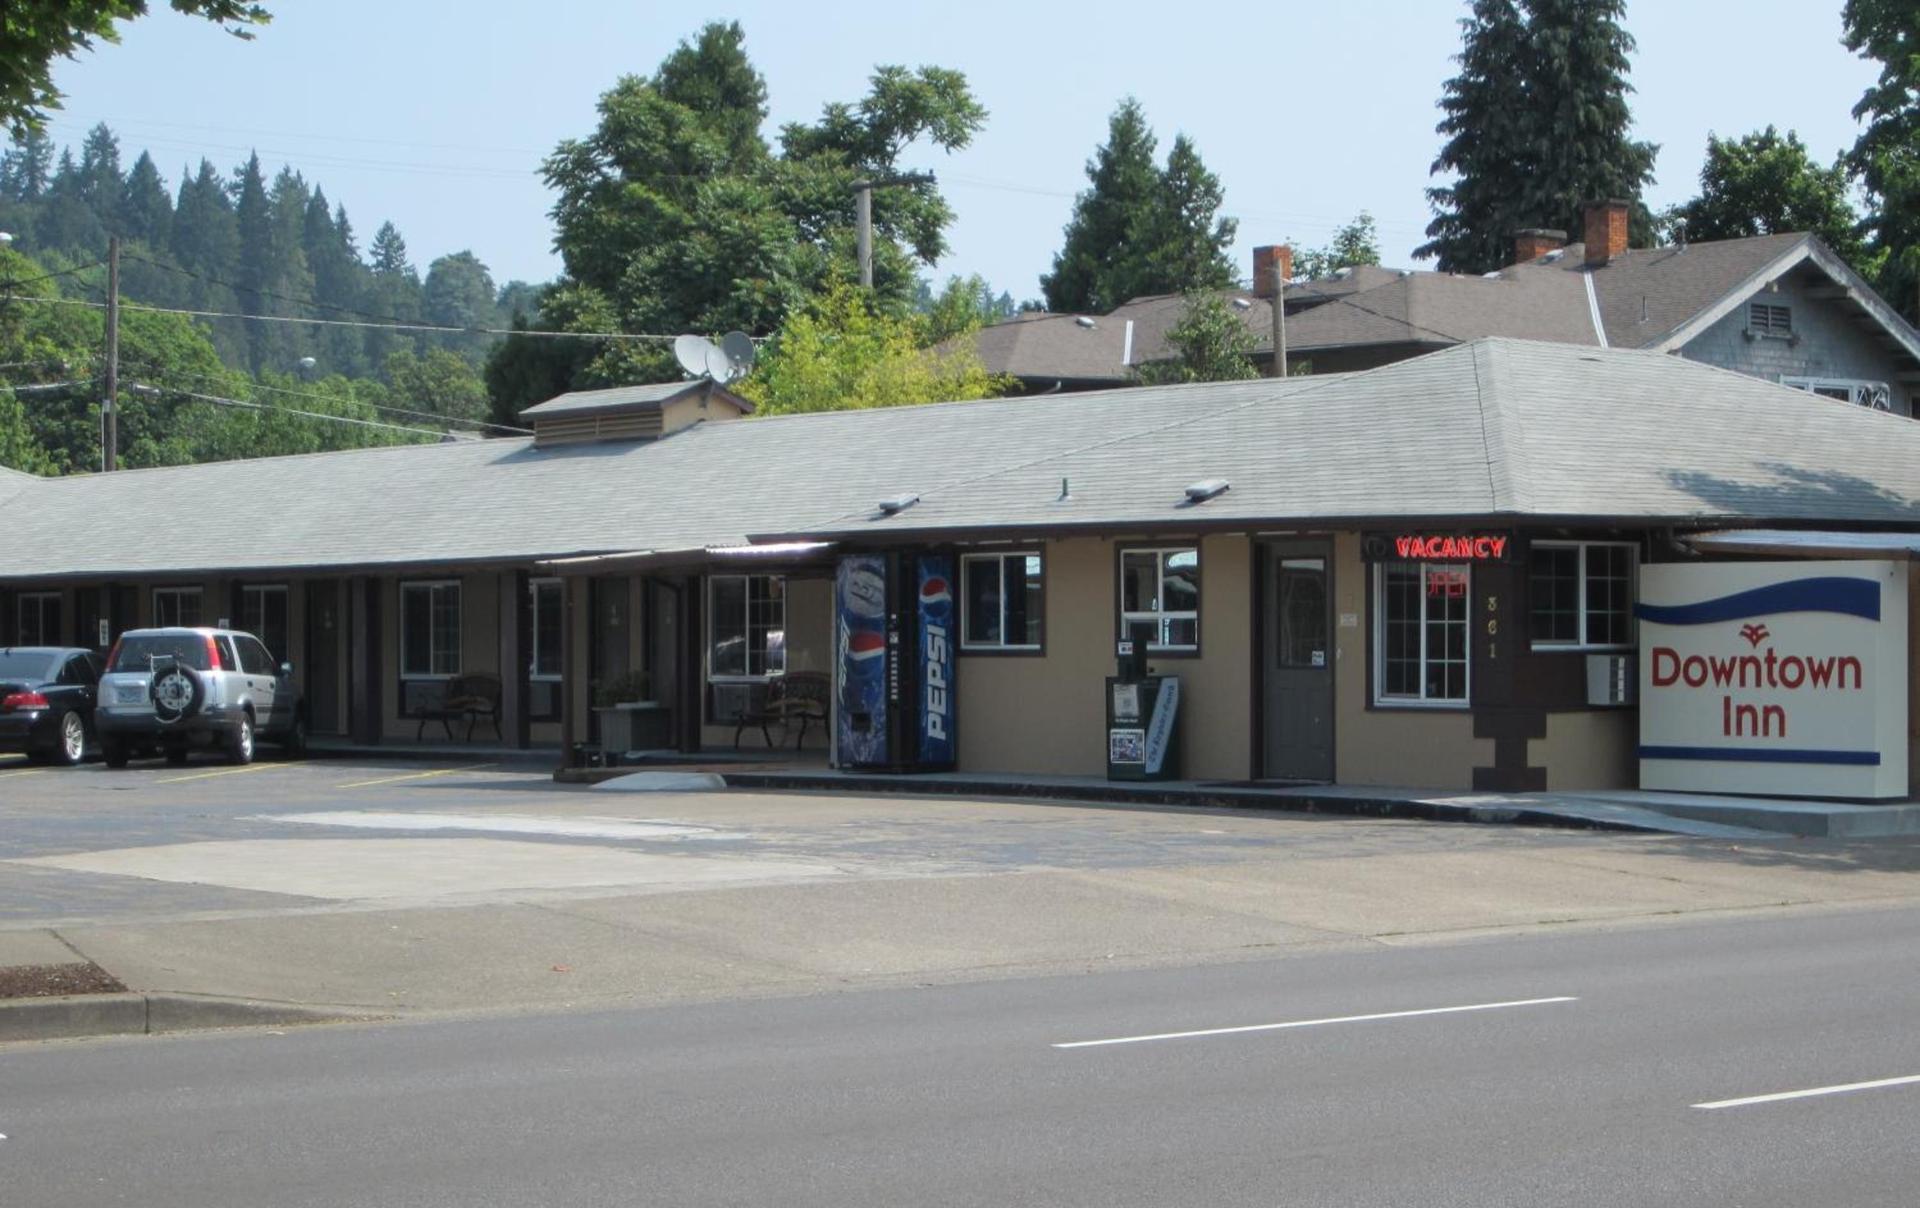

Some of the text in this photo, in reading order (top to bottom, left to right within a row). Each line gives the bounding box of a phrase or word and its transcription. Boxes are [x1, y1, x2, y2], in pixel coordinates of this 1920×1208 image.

[1396, 536, 1507, 558] VACANCY
[927, 624, 946, 740] PEPSI
[1652, 647, 1862, 689] Downtown
[1723, 696, 1786, 737] Inn
